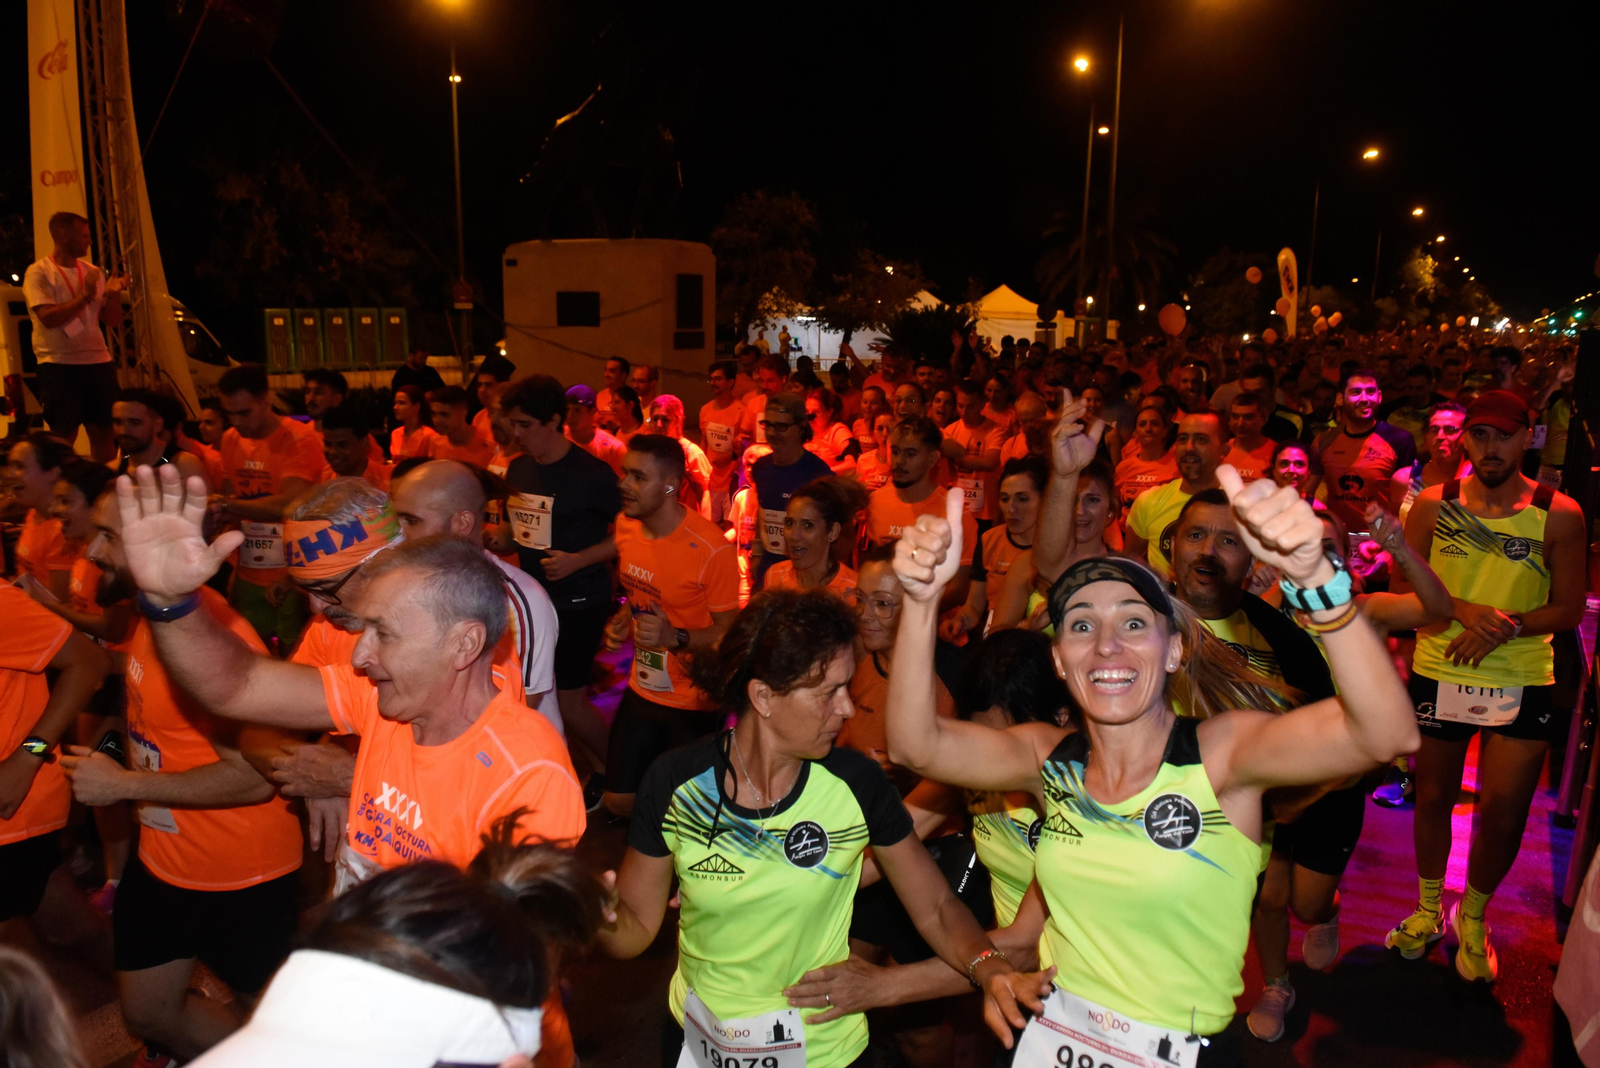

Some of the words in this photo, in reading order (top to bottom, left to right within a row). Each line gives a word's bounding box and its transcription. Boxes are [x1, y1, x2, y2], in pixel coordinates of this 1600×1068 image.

[1135, 474, 1157, 482] XXXV
[515, 512, 540, 526] 15271
[628, 563, 654, 583] XXXV
[375, 781, 423, 831] XXXV
[957, 870, 970, 893] EVADICT
[1039, 1018, 1052, 1027] XXXV
[1052, 1023, 1074, 1036] CARRERA
[1074, 1032, 1101, 1049] NOCTURNA
